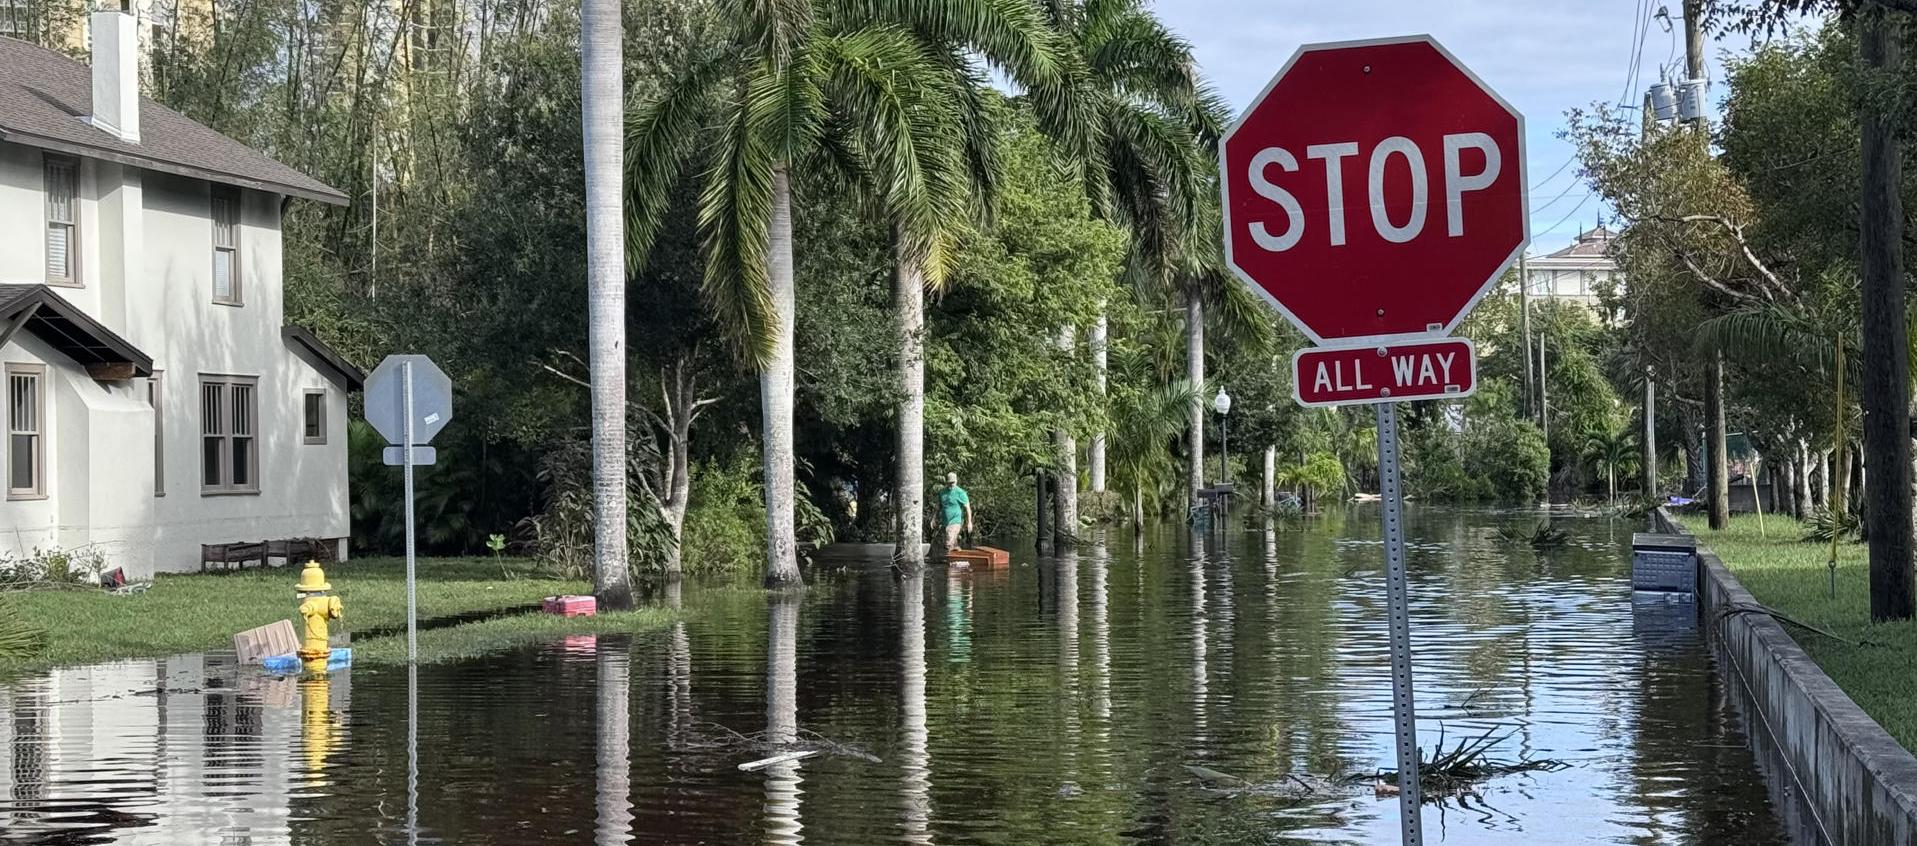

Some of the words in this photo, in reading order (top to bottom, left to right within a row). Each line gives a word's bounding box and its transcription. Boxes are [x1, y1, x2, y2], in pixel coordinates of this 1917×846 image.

[1248, 132, 1501, 252] STOP
[1313, 358, 1373, 393] ALL
[1391, 352, 1456, 387] WAY
